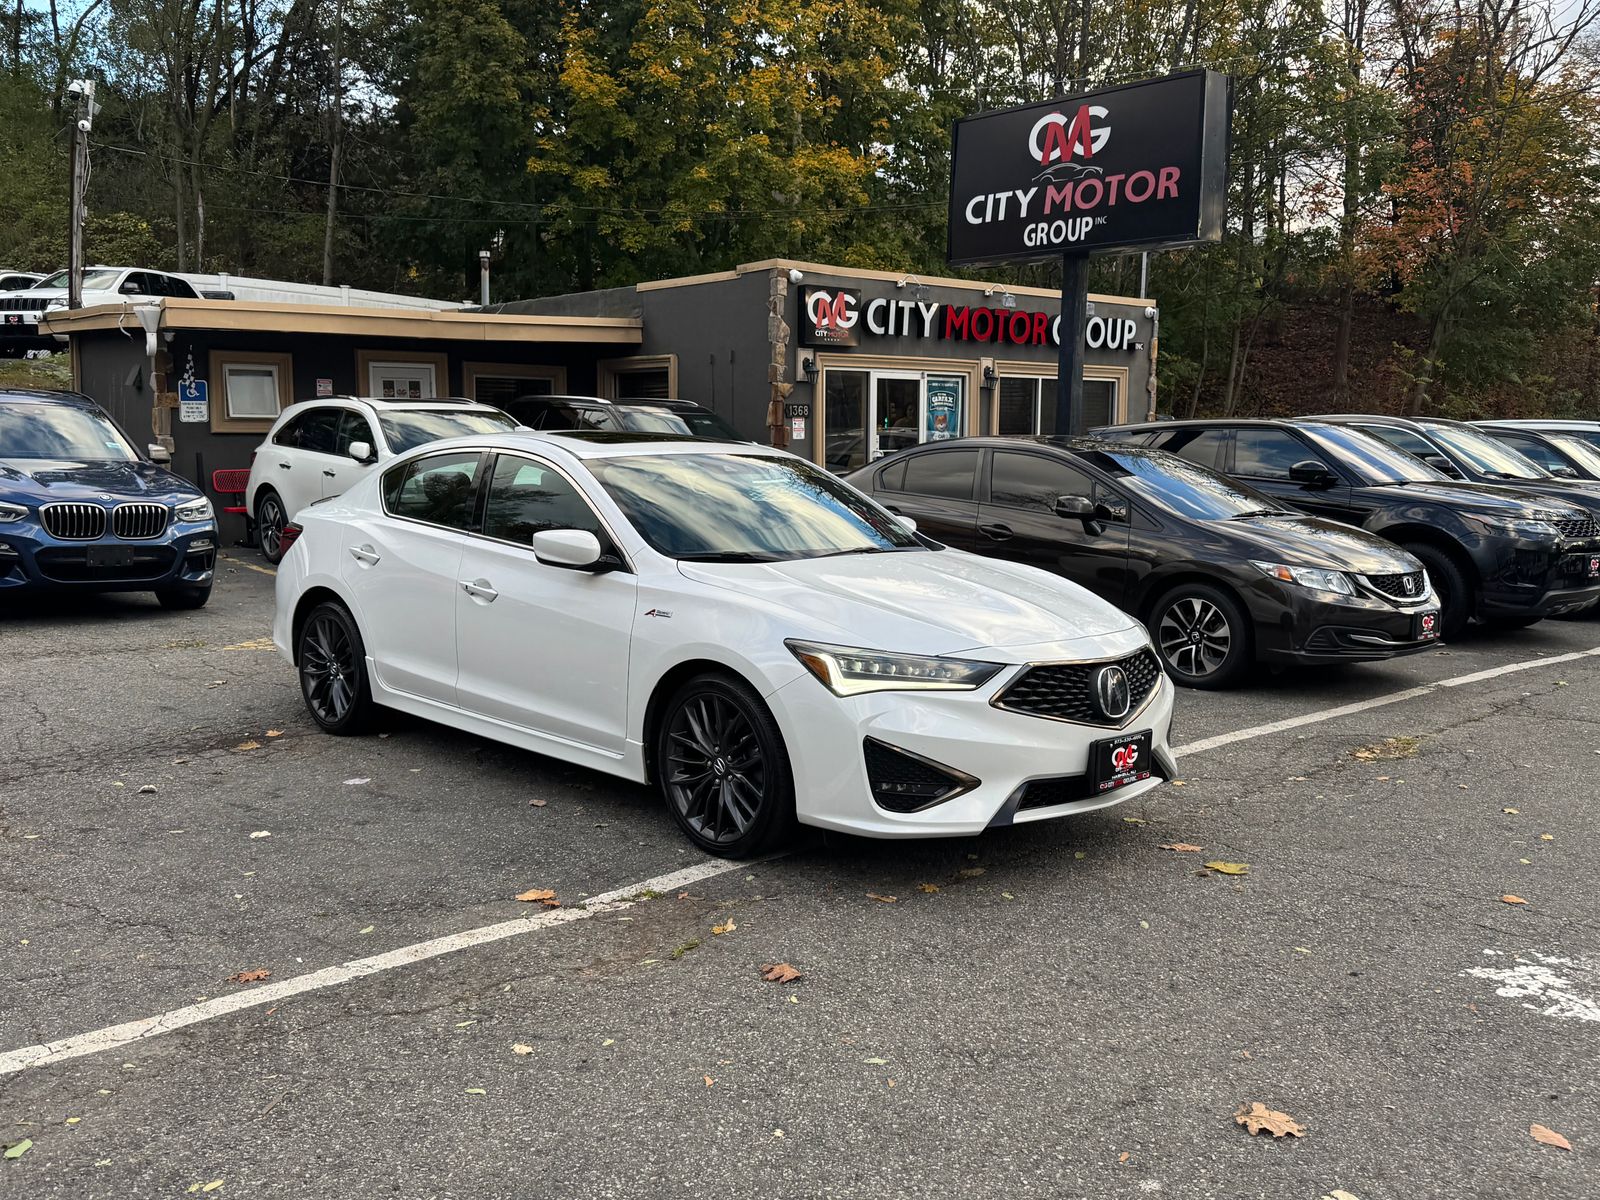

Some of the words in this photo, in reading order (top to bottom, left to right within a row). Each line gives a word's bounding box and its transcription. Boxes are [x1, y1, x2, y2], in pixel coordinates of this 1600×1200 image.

[965, 186, 1038, 225] CITY
[1043, 166, 1181, 215] MOTOR
[1023, 216, 1093, 247] GROUP
[1095, 215, 1108, 225] INC
[866, 298, 939, 338] CITY
[945, 304, 1048, 346] MOTOR
[1052, 314, 1137, 350] OUP
[1135, 342, 1144, 350] INC
[789, 405, 809, 416] 1368
